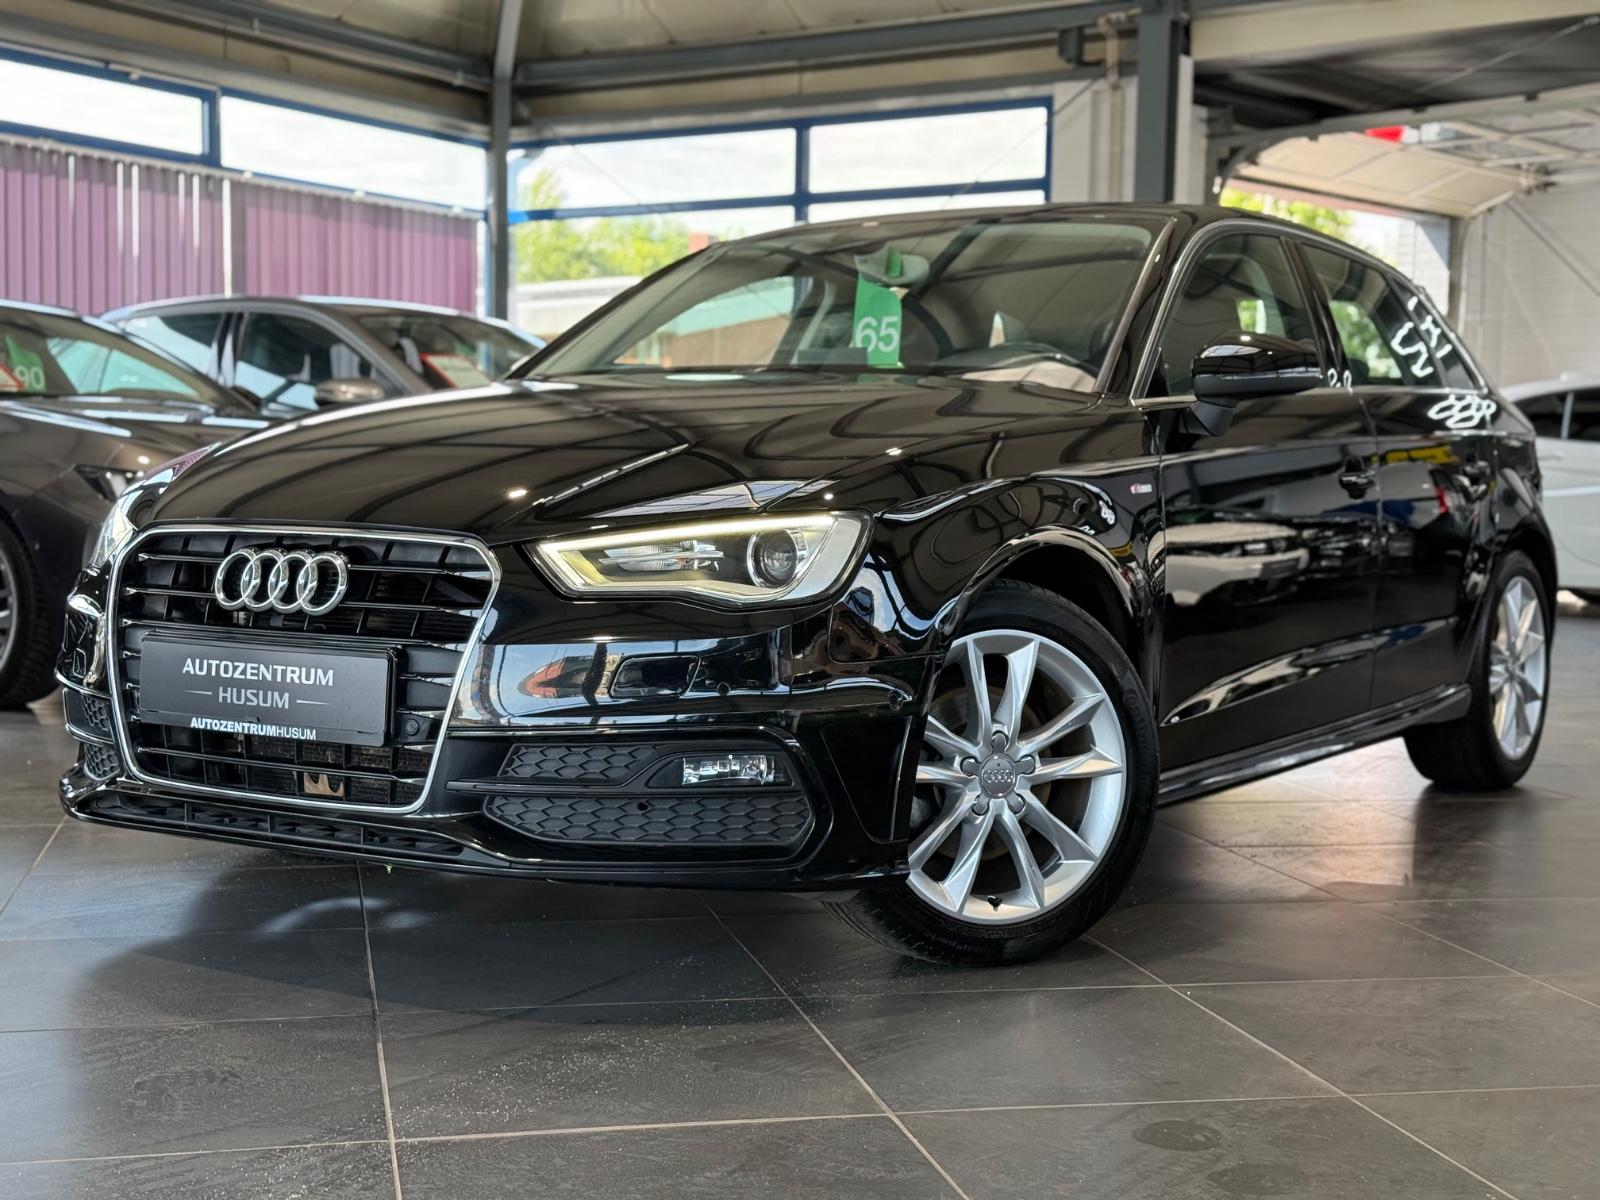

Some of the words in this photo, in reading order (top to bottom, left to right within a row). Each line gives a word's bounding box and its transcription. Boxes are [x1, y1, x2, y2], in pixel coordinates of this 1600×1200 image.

[855, 315, 899, 353] 65
[15, 365, 45, 389] 90
[182, 658, 334, 687] AUTOZENTRUM
[218, 687, 290, 709] HUSUM
